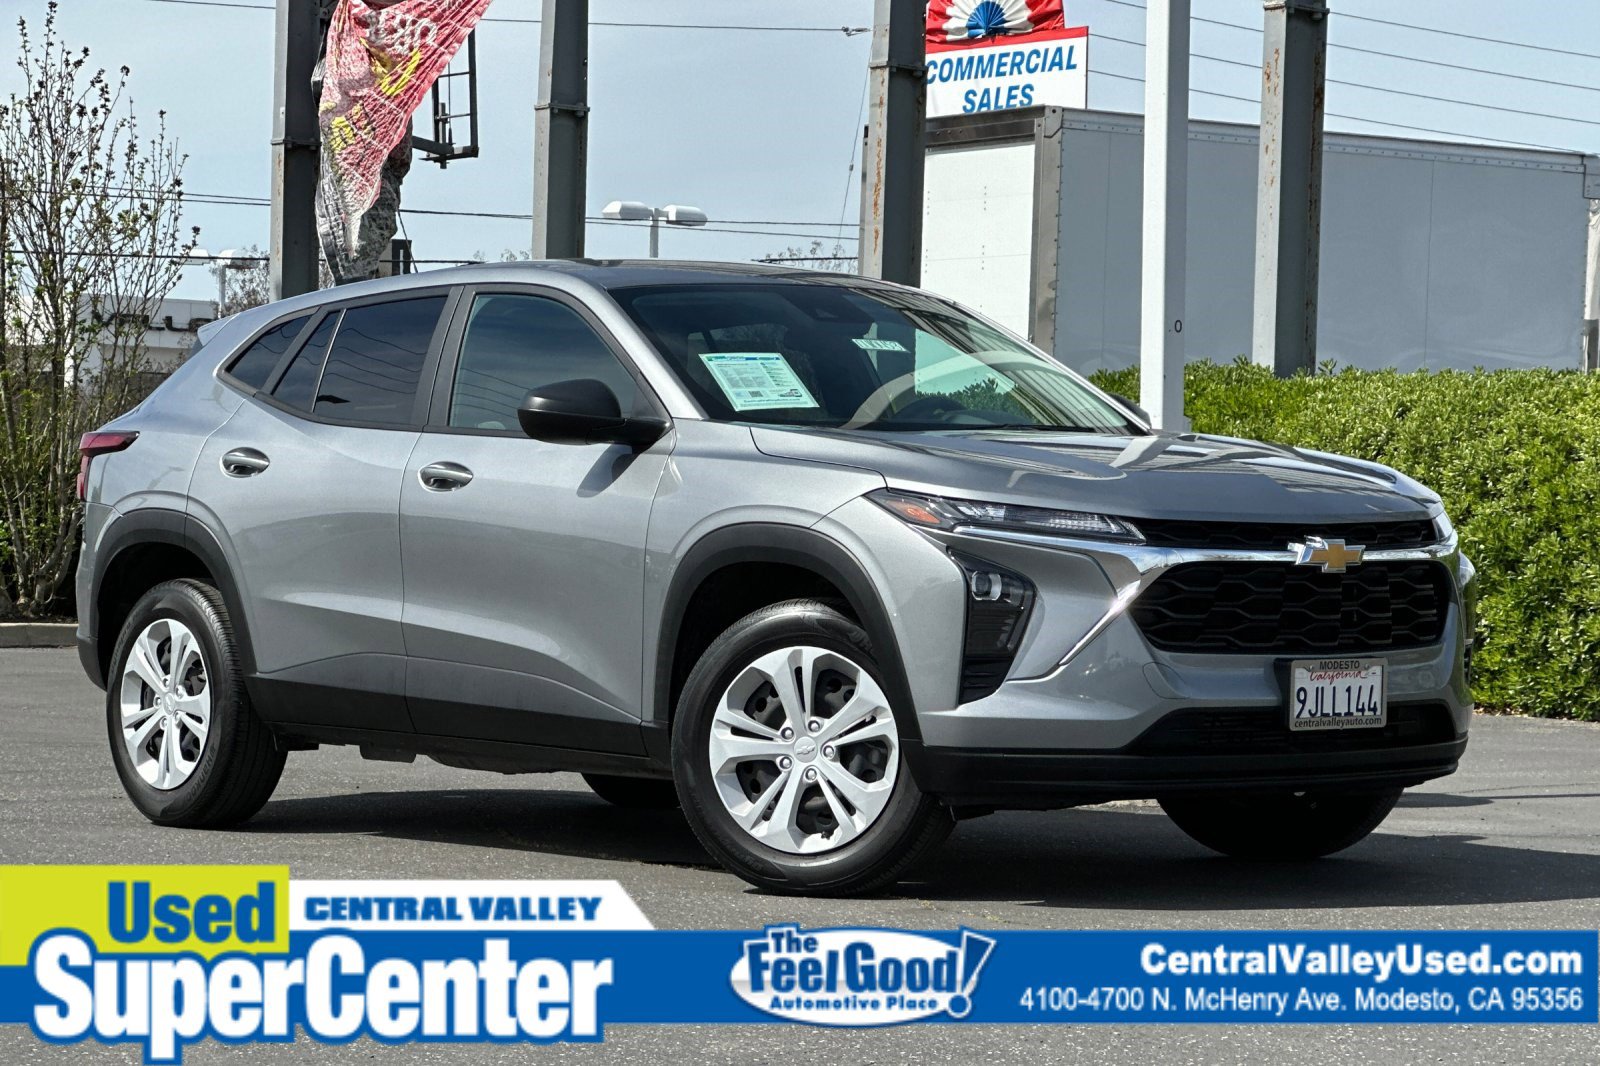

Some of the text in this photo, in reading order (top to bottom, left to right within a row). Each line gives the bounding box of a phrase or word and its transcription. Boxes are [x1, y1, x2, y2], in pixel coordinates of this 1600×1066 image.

[927, 45, 1077, 84] COMMERCIAL
[962, 83, 1034, 114] SALES
[1320, 660, 1360, 670] MODESTO
[1295, 685, 1378, 719] 9JLL144
[1294, 717, 1382, 729] centralvalleyauto.com
